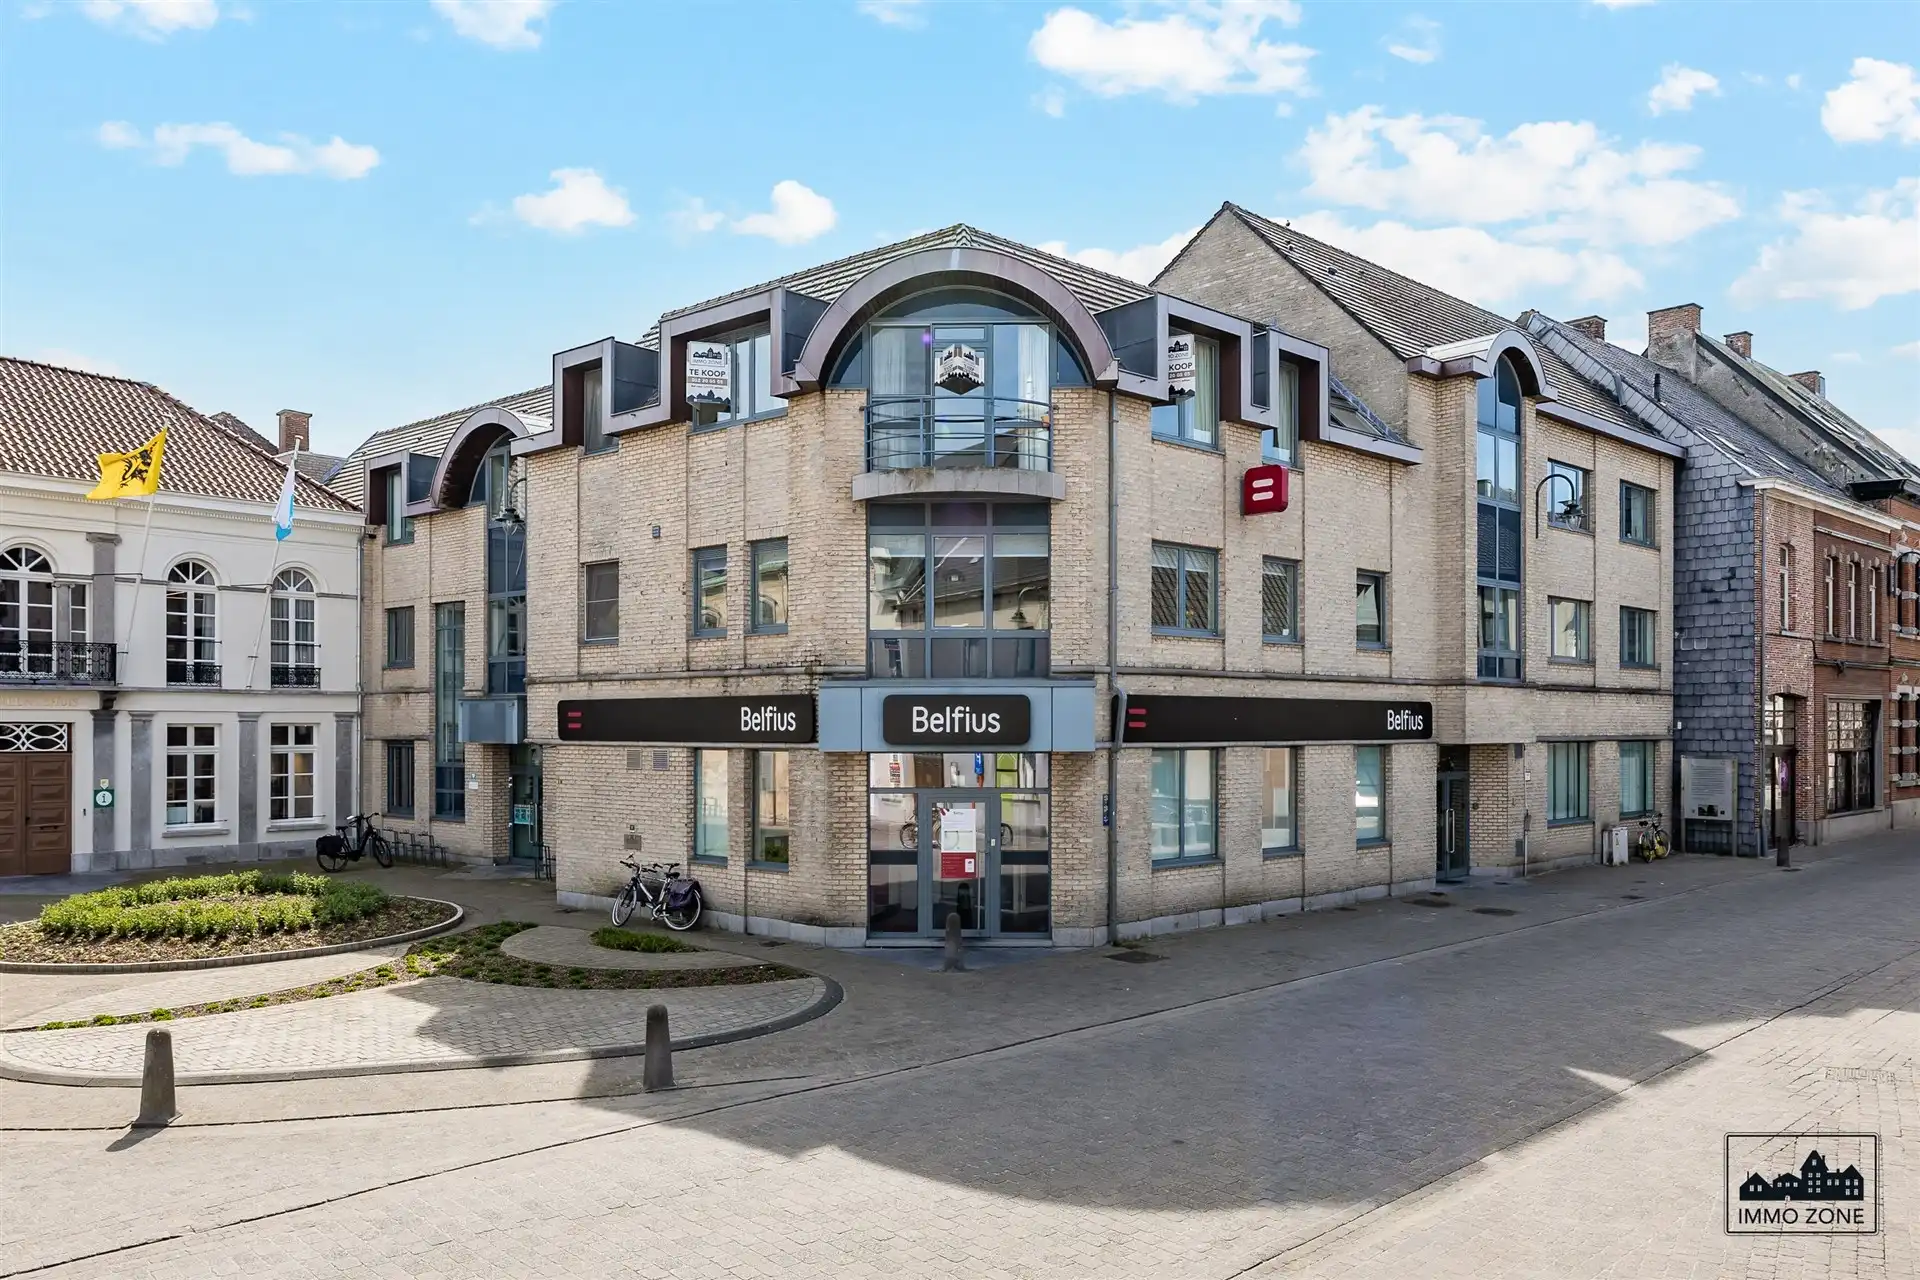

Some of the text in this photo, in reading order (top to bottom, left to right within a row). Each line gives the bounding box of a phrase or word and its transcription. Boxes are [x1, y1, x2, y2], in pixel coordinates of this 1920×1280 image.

[701, 369, 726, 377] KOOP
[1168, 362, 1193, 371] KOOP
[740, 706, 796, 732] Belfius
[912, 706, 1001, 733] Belfius
[1387, 709, 1424, 731] Belfius
